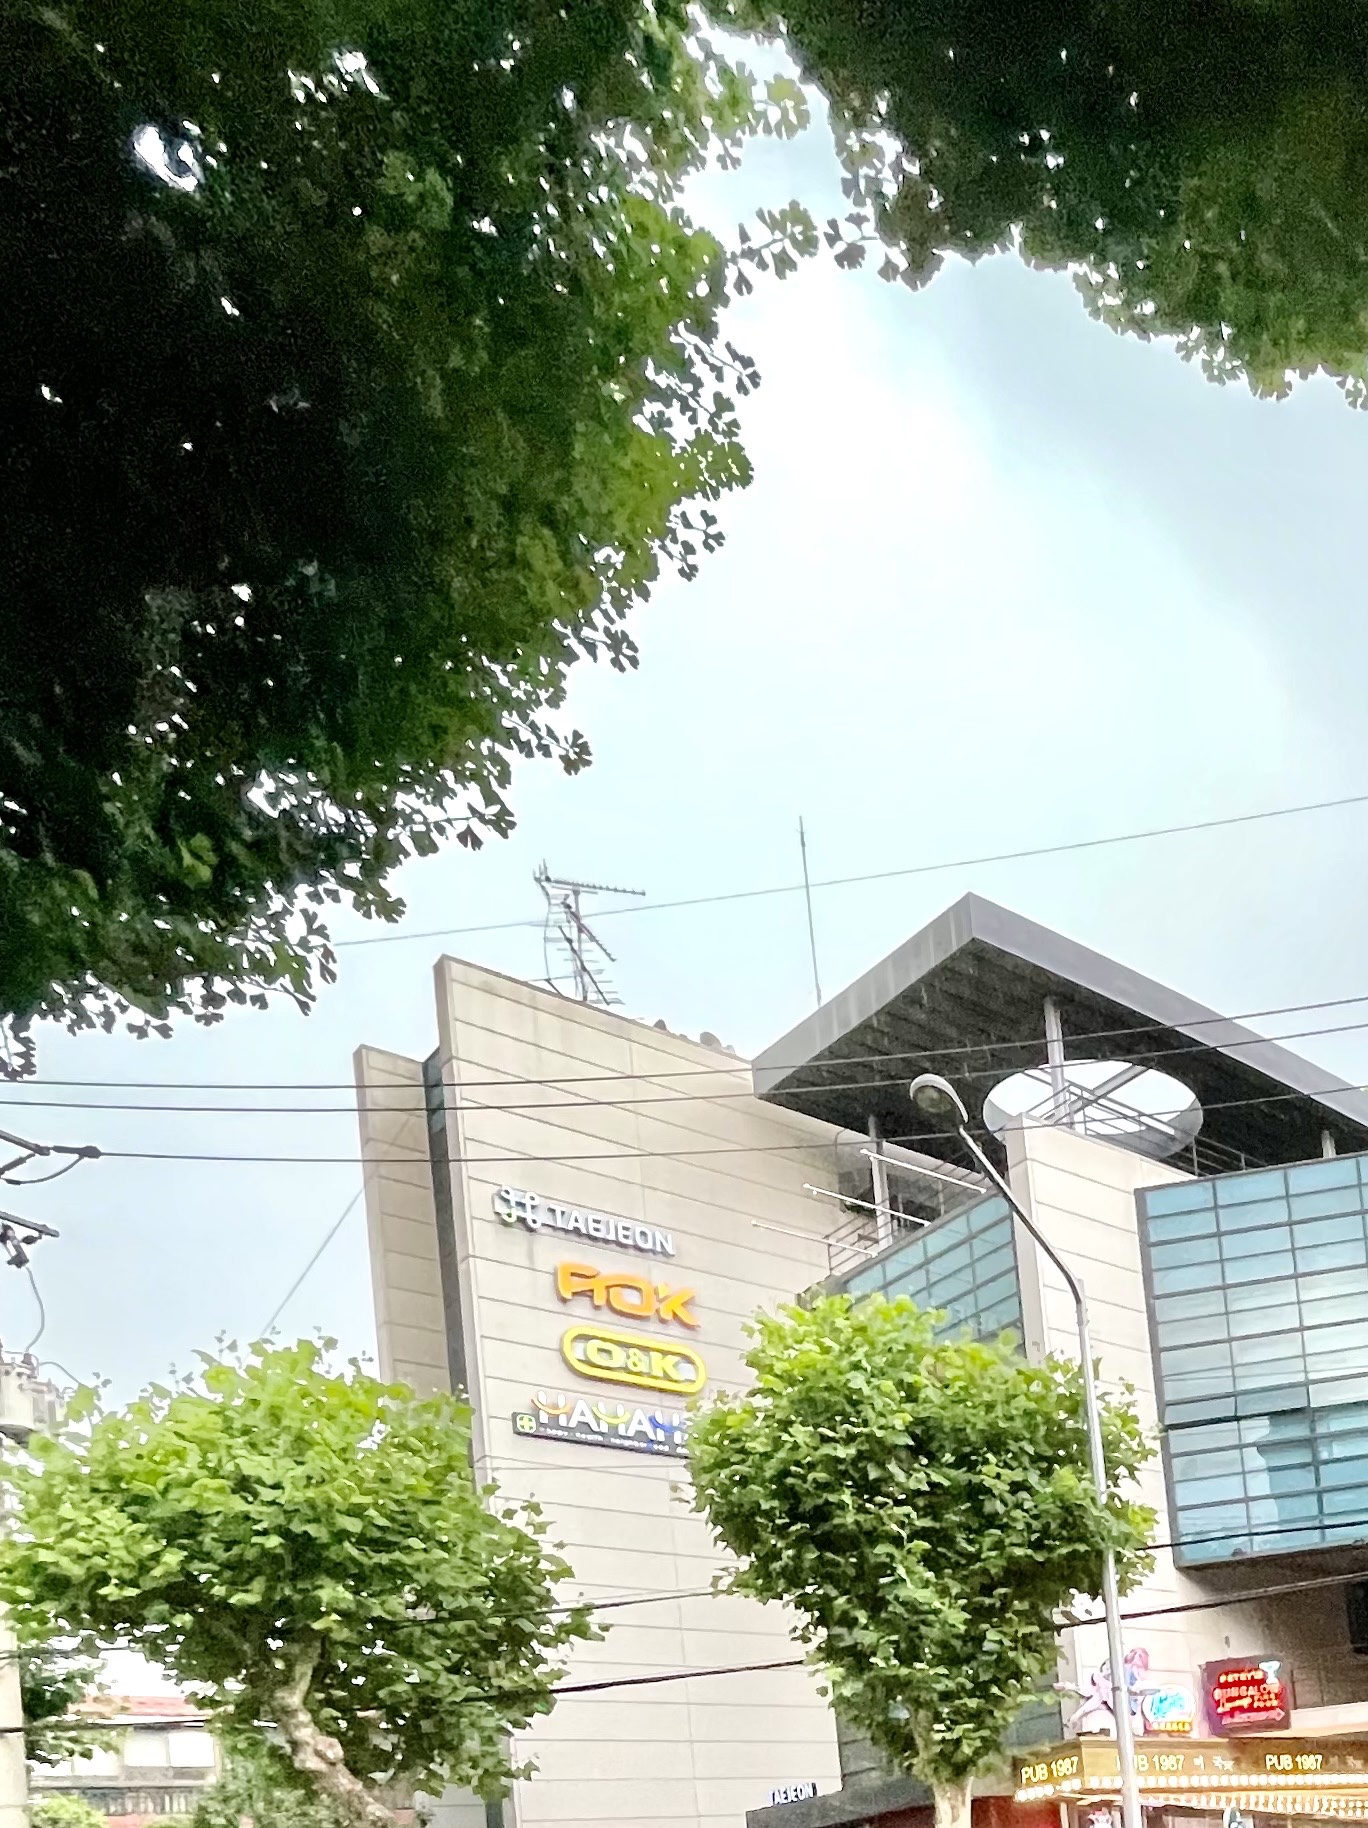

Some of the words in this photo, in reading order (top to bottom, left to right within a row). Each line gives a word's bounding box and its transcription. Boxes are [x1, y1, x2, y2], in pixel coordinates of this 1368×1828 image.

[1021, 1763, 1049, 1784] PUB
[1051, 1756, 1079, 1777] 1987
[1152, 1754, 1185, 1771] 1987
[1265, 1754, 1293, 1770] PUB
[1295, 1753, 1323, 1770] 1987
